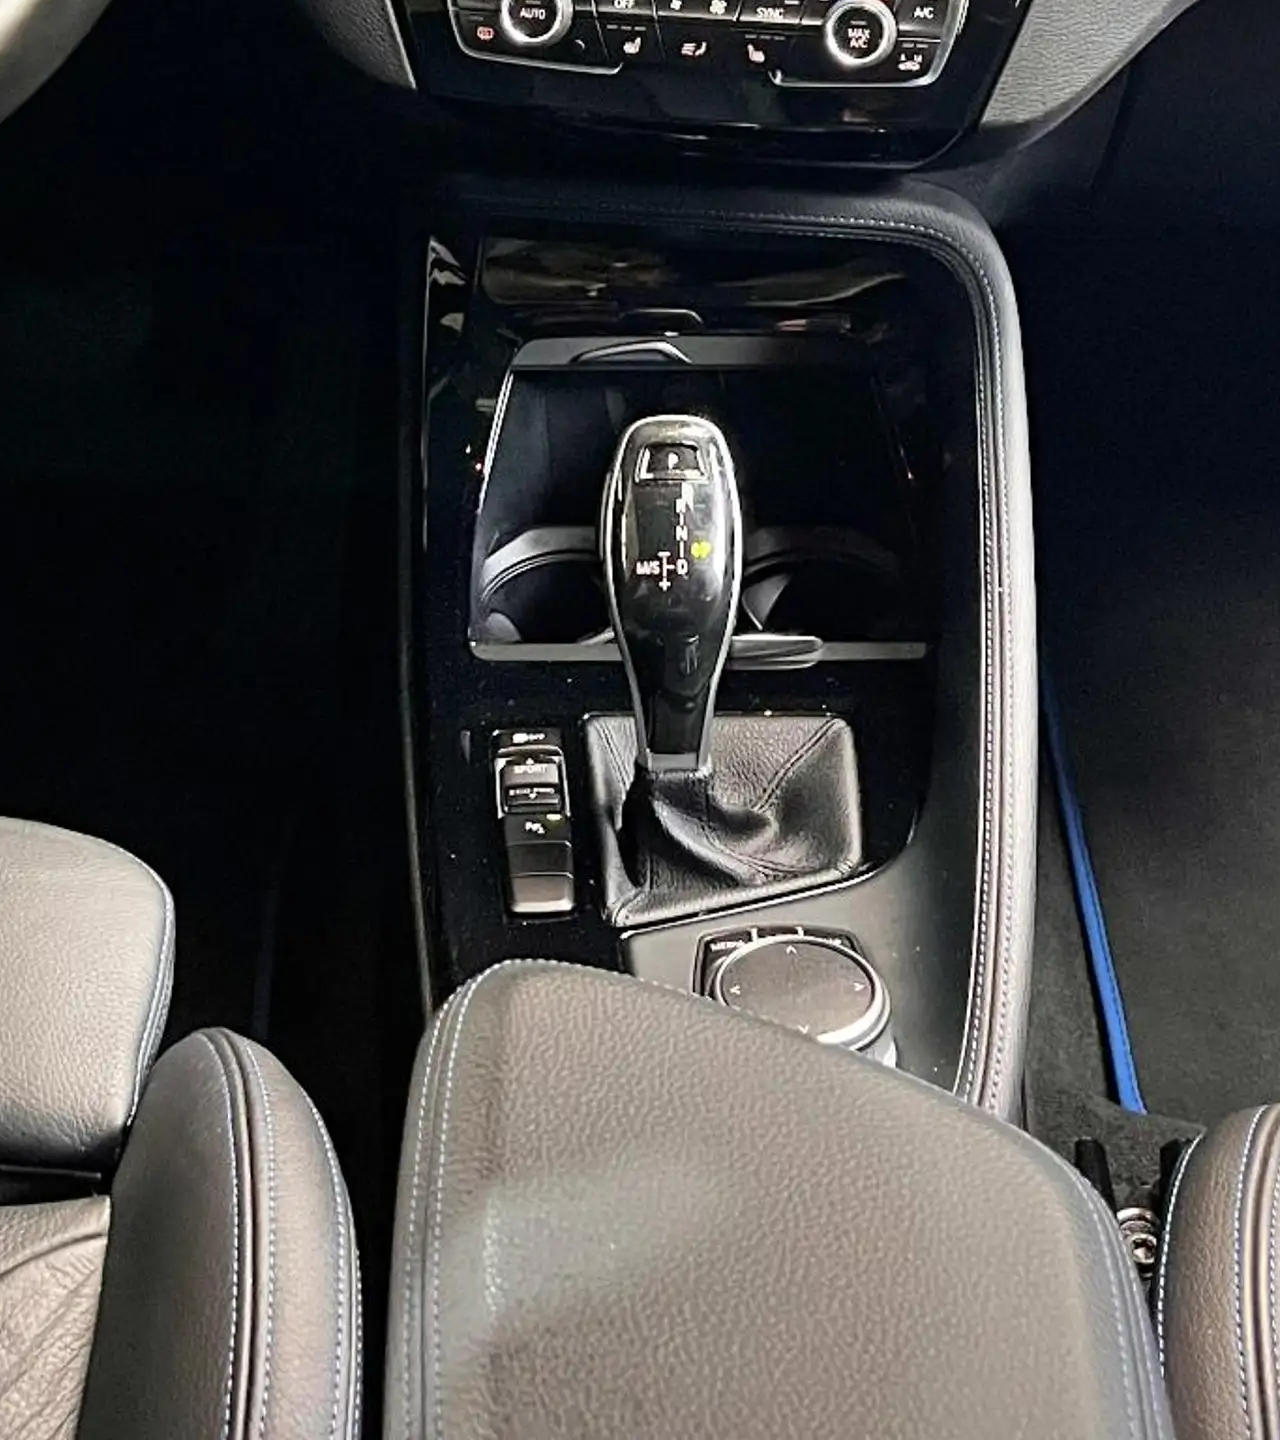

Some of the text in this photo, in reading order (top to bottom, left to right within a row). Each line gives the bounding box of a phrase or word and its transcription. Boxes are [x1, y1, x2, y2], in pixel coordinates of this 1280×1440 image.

[520, 8, 546, 20] AUTO
[756, 6, 784, 19] SYNC
[914, 7, 934, 19] A/C
[847, 28, 871, 38] MAX
[850, 37, 868, 49] A/C
[668, 452, 680, 470] P
[676, 525, 688, 541] N
[677, 563, 688, 575] D
[514, 764, 548, 774] SPORT
